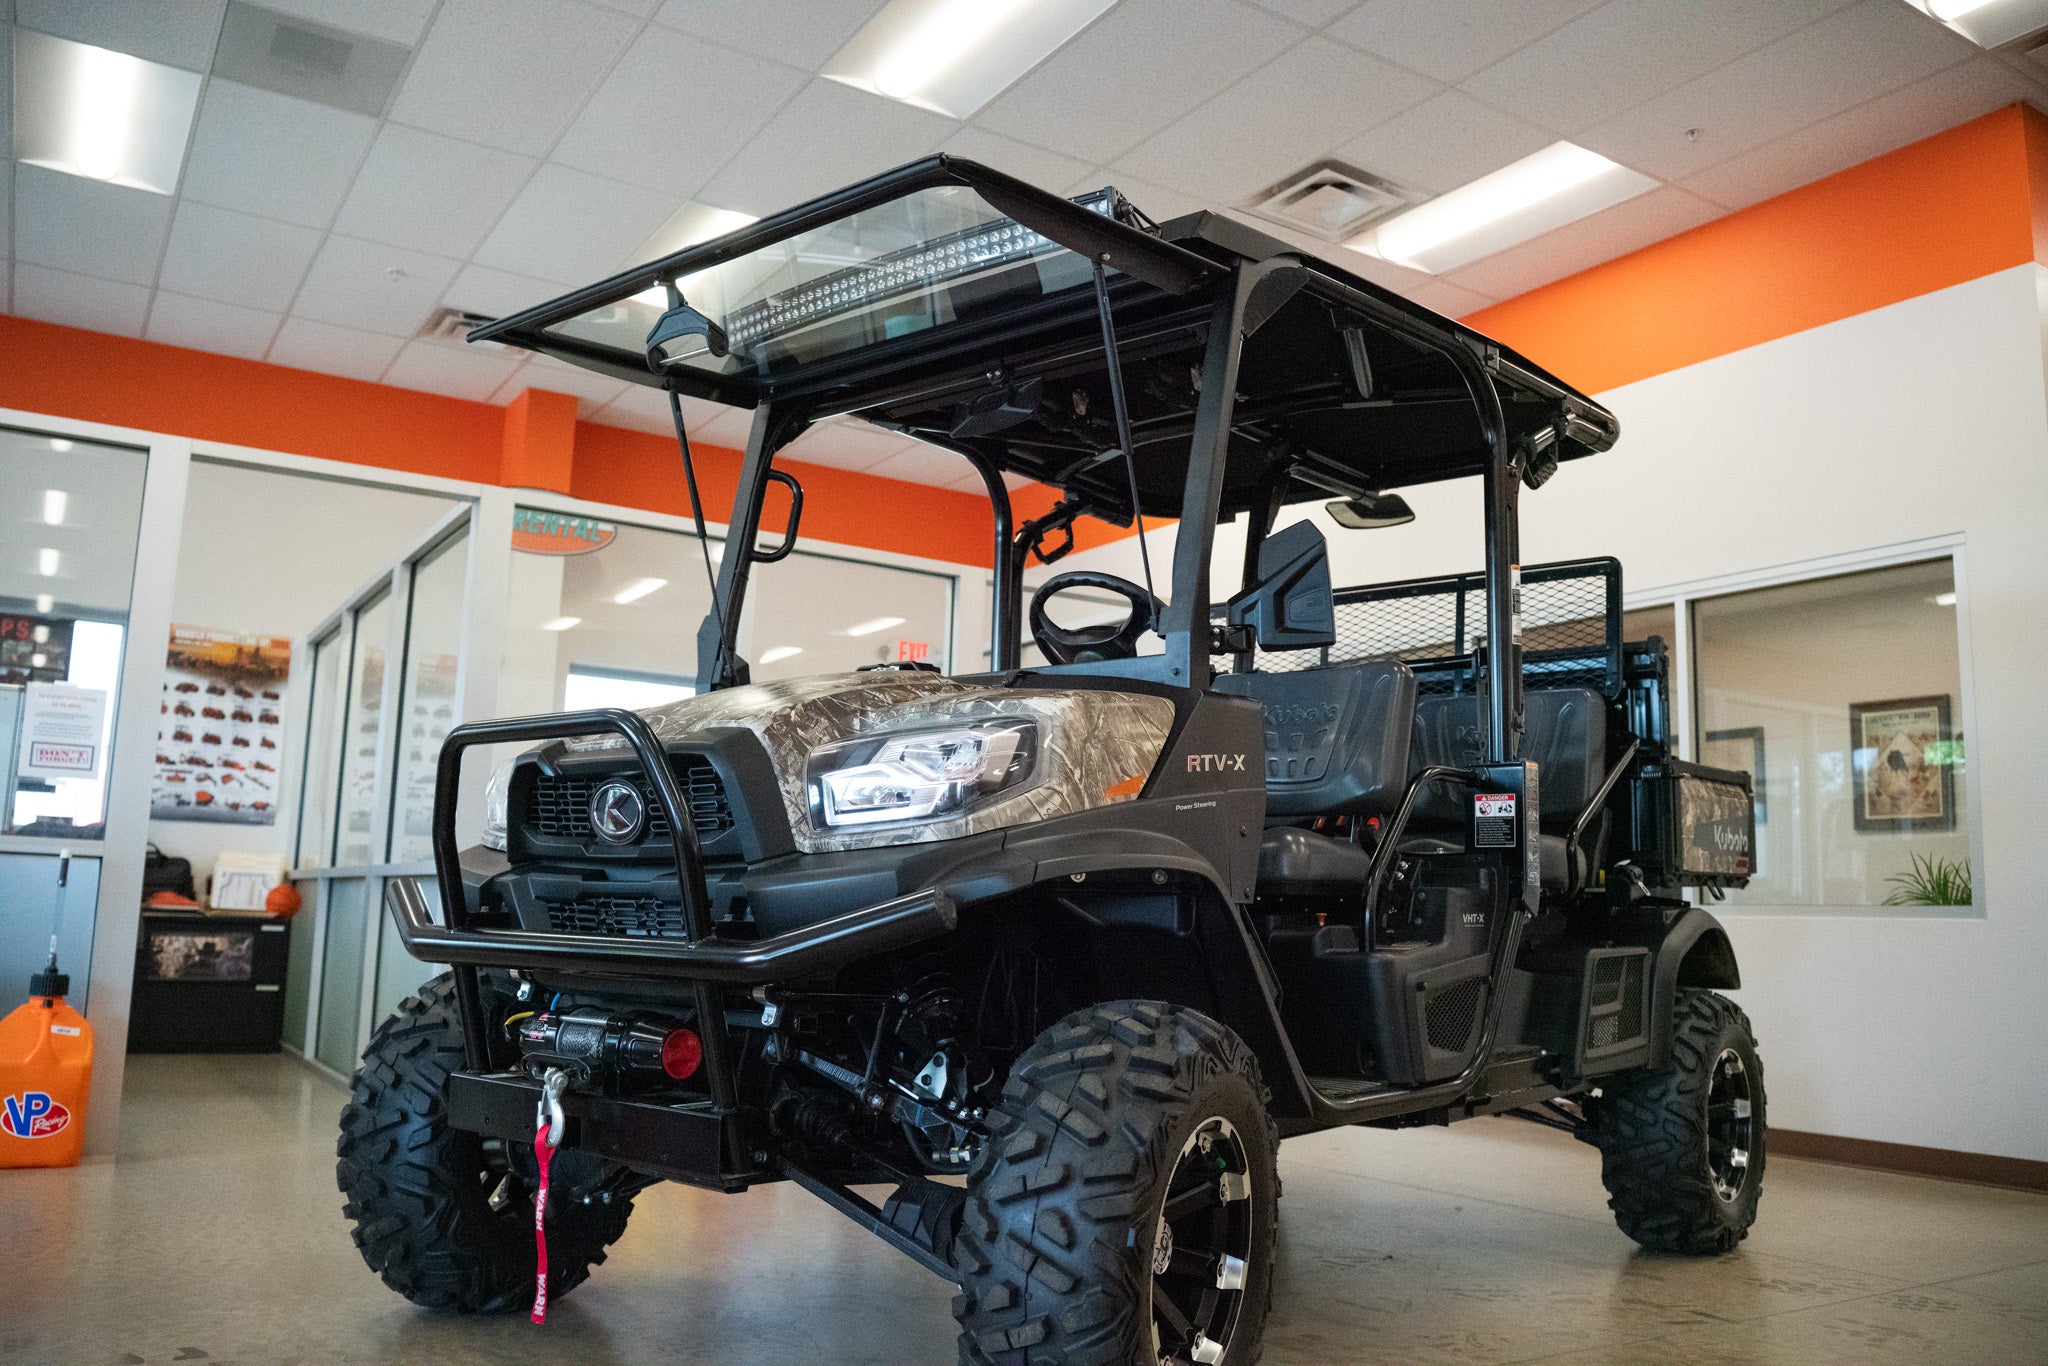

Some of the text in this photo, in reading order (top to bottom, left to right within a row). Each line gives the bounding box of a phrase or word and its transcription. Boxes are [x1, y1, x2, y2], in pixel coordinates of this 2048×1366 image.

[512, 507, 601, 542] RENTAL
[1187, 754, 1245, 773] RTV-X
[1175, 800, 1217, 811] Power Steering
[1713, 824, 1749, 851] Kubota
[4, 1091, 52, 1136] VP
[33, 1113, 69, 1133] Racing
[535, 1188, 546, 1231] WARN
[534, 1273, 546, 1316] WARN
